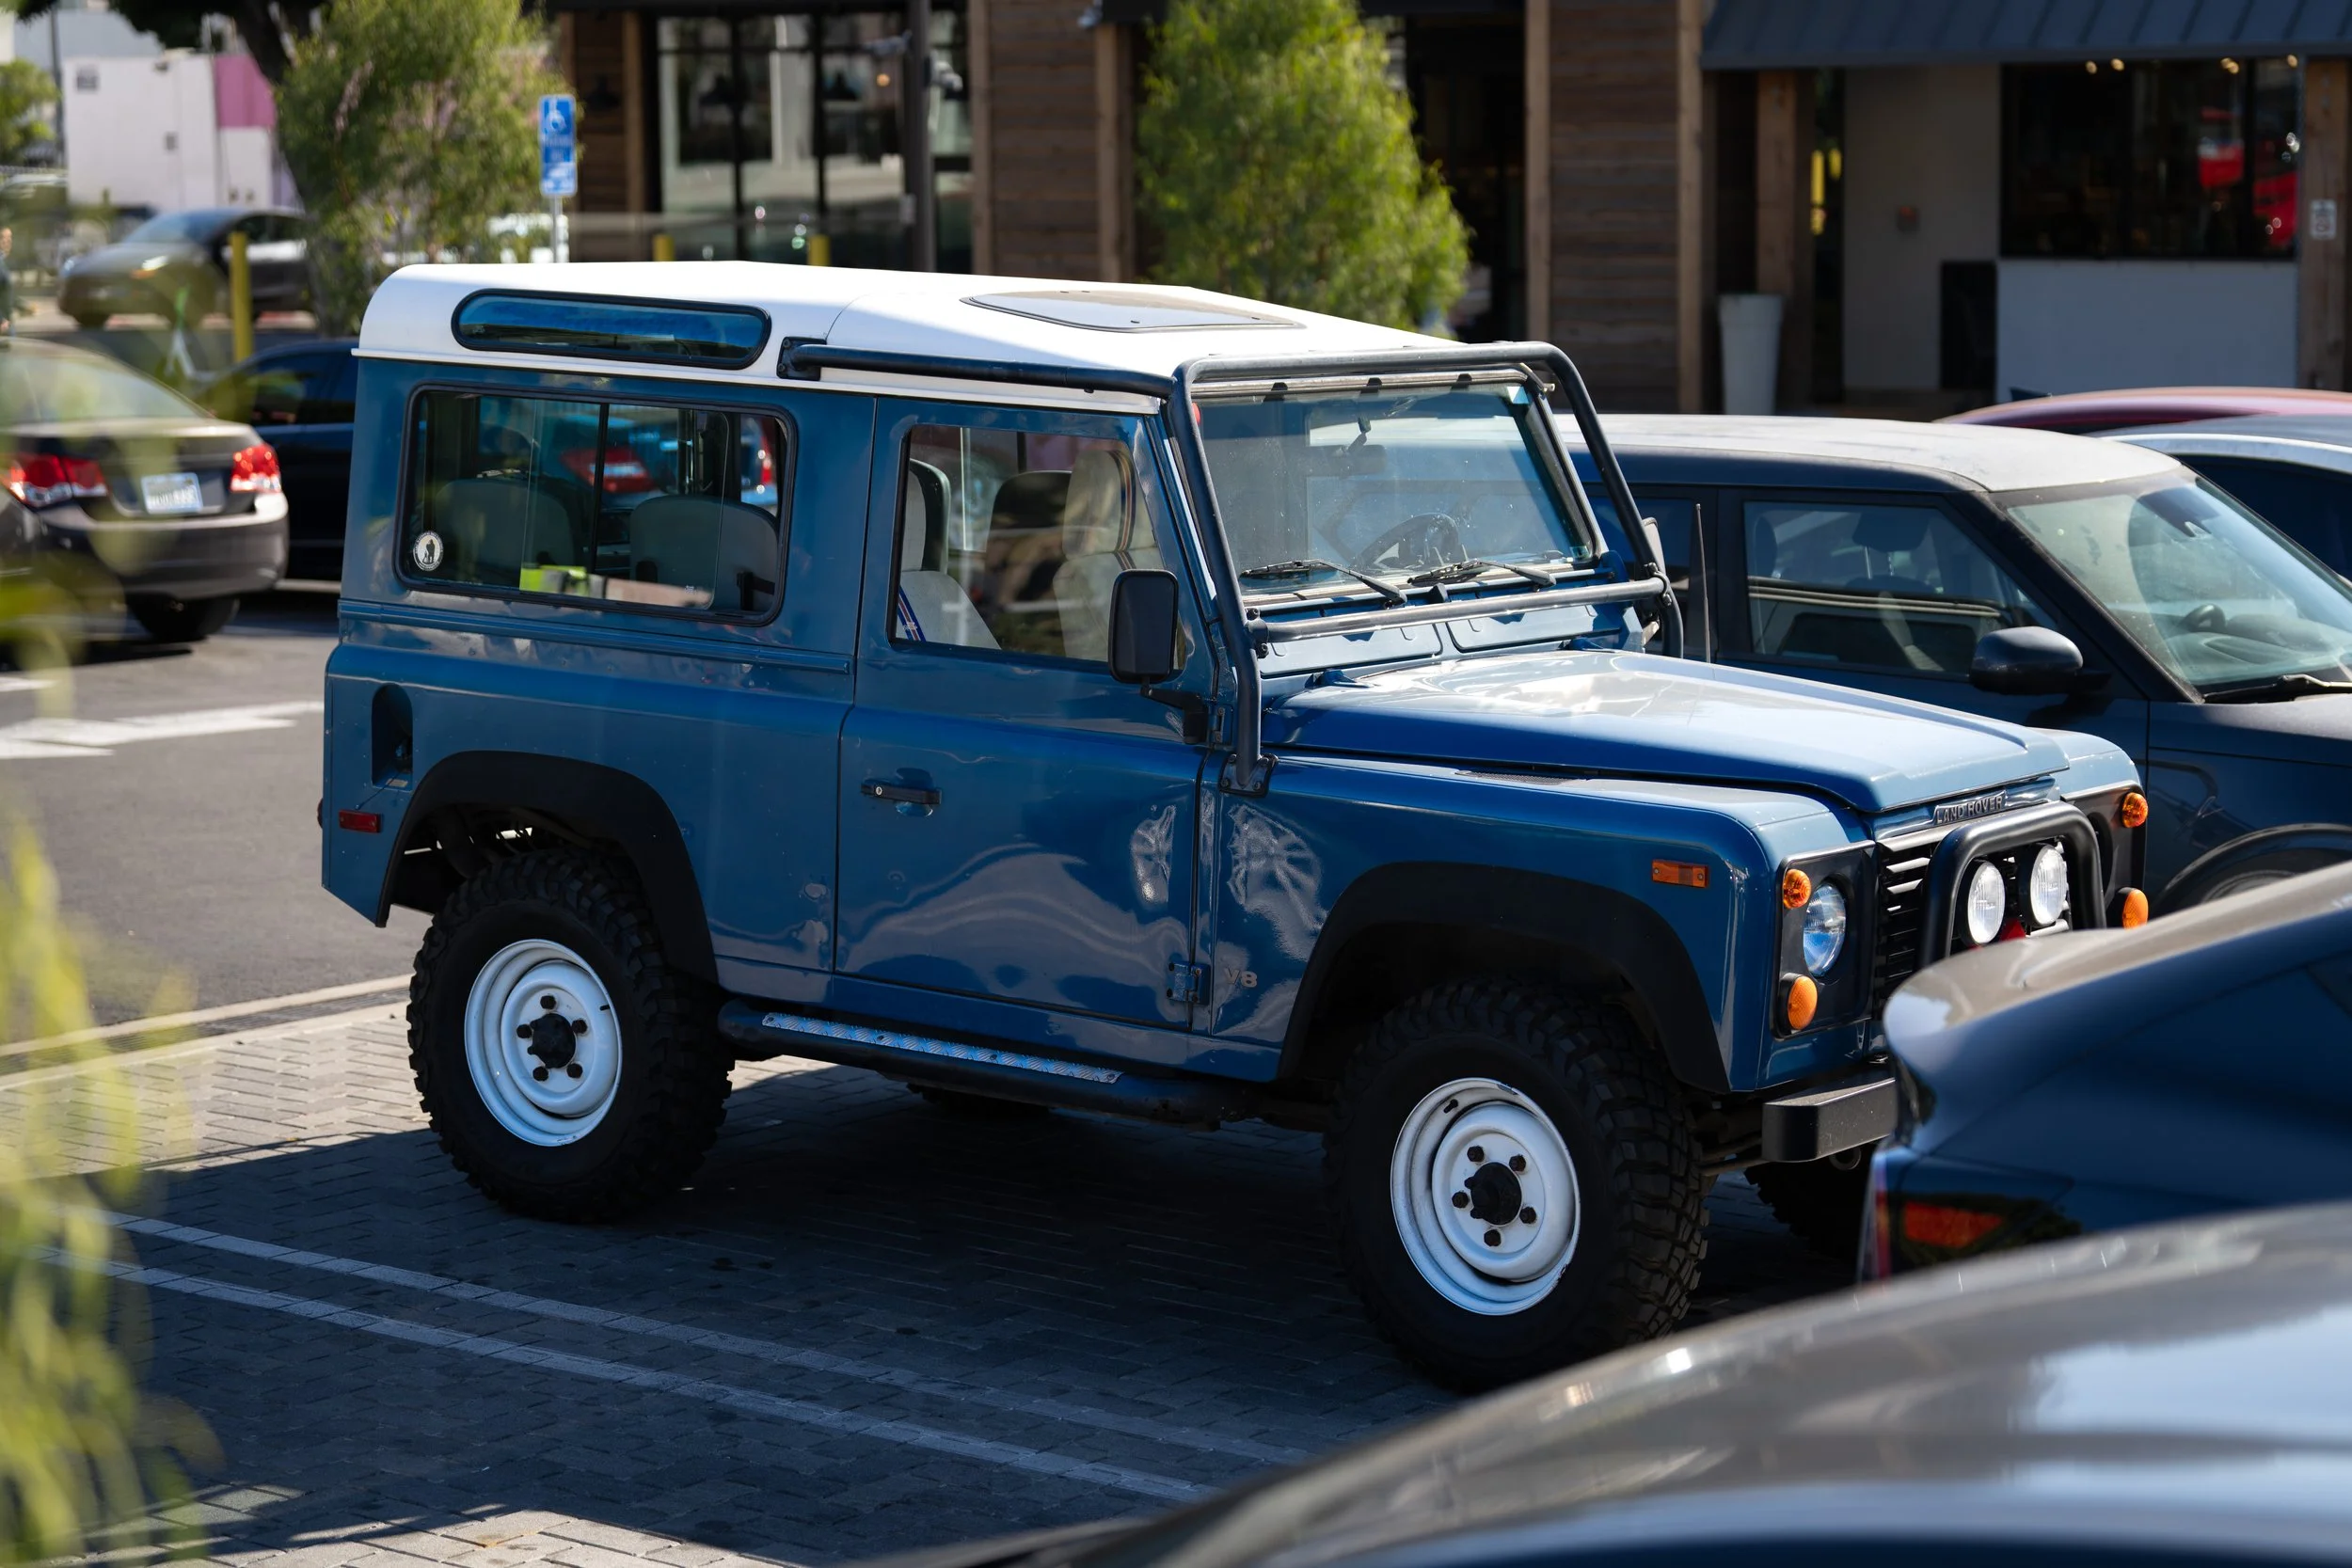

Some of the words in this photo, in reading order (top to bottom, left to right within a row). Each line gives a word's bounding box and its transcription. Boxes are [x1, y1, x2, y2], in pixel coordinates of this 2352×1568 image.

[1936, 804, 1965, 824] LAND
[1968, 796, 2003, 816] ROVER
[1223, 967, 1258, 988] V8
